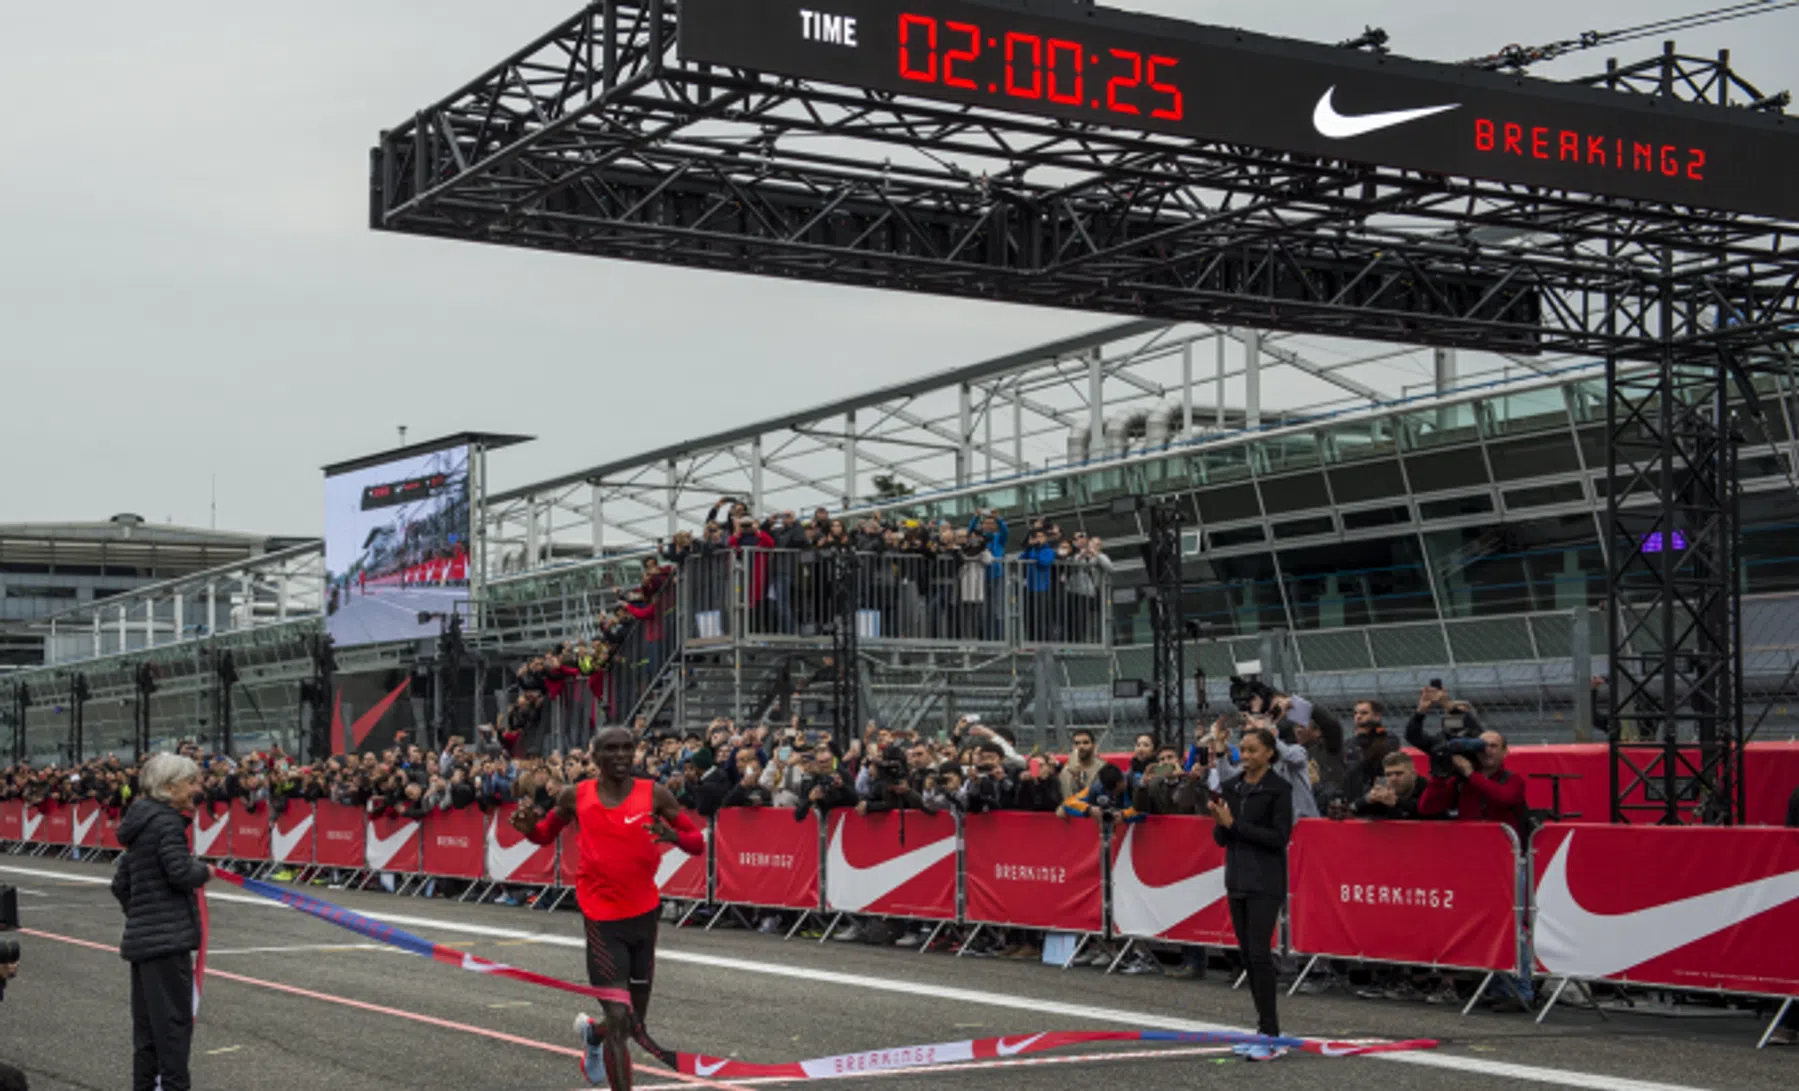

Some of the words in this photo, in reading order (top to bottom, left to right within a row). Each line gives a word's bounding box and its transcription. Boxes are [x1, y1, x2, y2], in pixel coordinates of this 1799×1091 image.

[800, 9, 858, 47] TIME
[898, 13, 1184, 121] 02:00:25
[1475, 118, 1706, 181] BREAKING2
[1340, 884, 1454, 909] BREAKING2
[835, 1047, 936, 1073] BREAKING2
